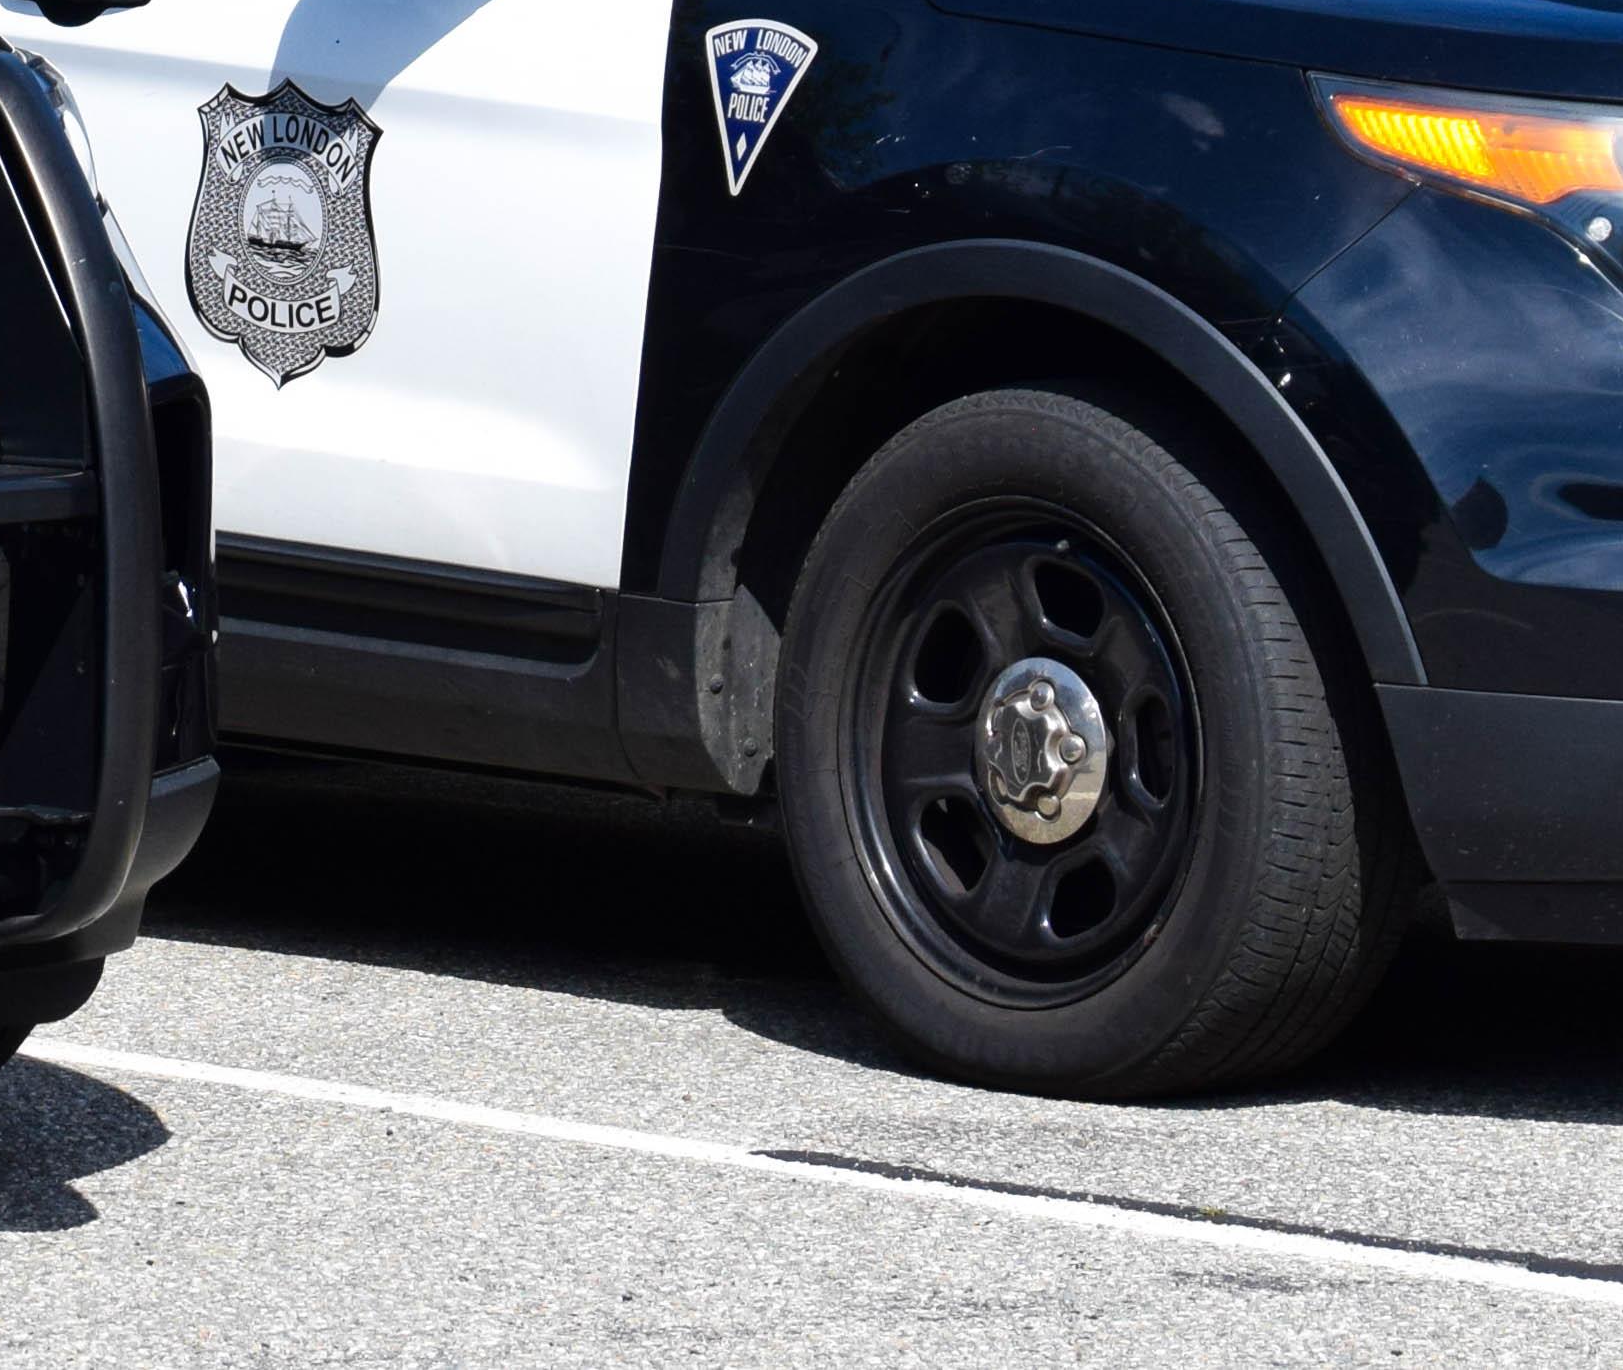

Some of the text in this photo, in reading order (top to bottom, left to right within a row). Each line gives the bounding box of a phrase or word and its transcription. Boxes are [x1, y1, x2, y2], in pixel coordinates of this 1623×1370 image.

[714, 29, 808, 68] NEW LONDON
[728, 93, 770, 123] POLICE
[220, 115, 357, 182] NEW LONDON
[228, 283, 337, 329] POLICE
